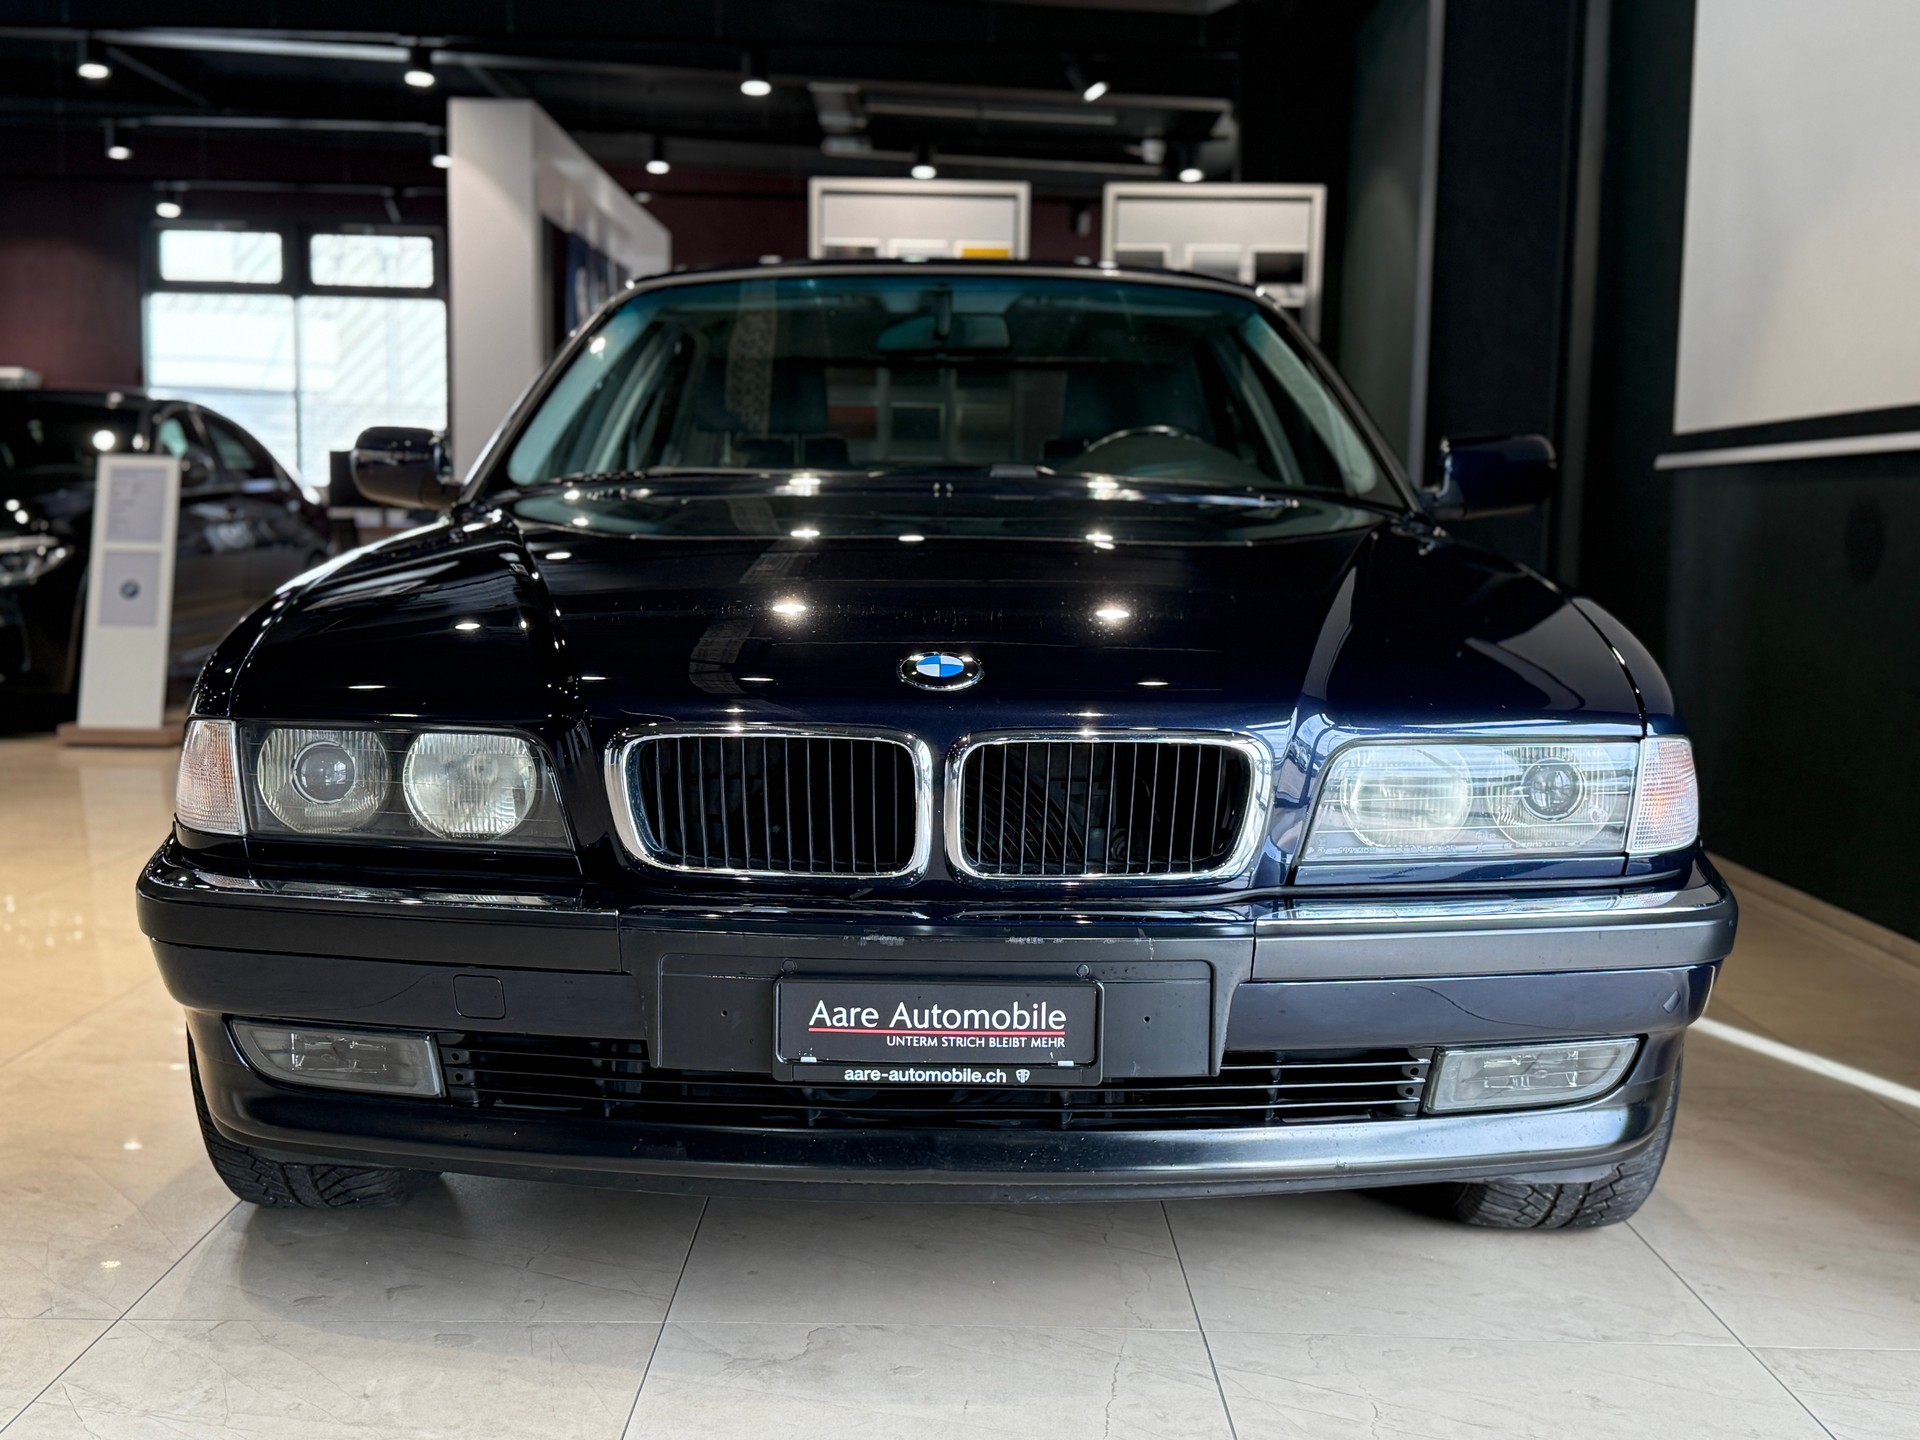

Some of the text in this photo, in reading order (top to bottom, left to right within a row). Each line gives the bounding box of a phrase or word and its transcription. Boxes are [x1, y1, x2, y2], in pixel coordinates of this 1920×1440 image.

[809, 1000, 1067, 1030] Aare Automobile
[887, 1036, 1066, 1048] UNTERM STRICH BLEIBT MEHR
[844, 1068, 1007, 1083] aare-automobile.ch
